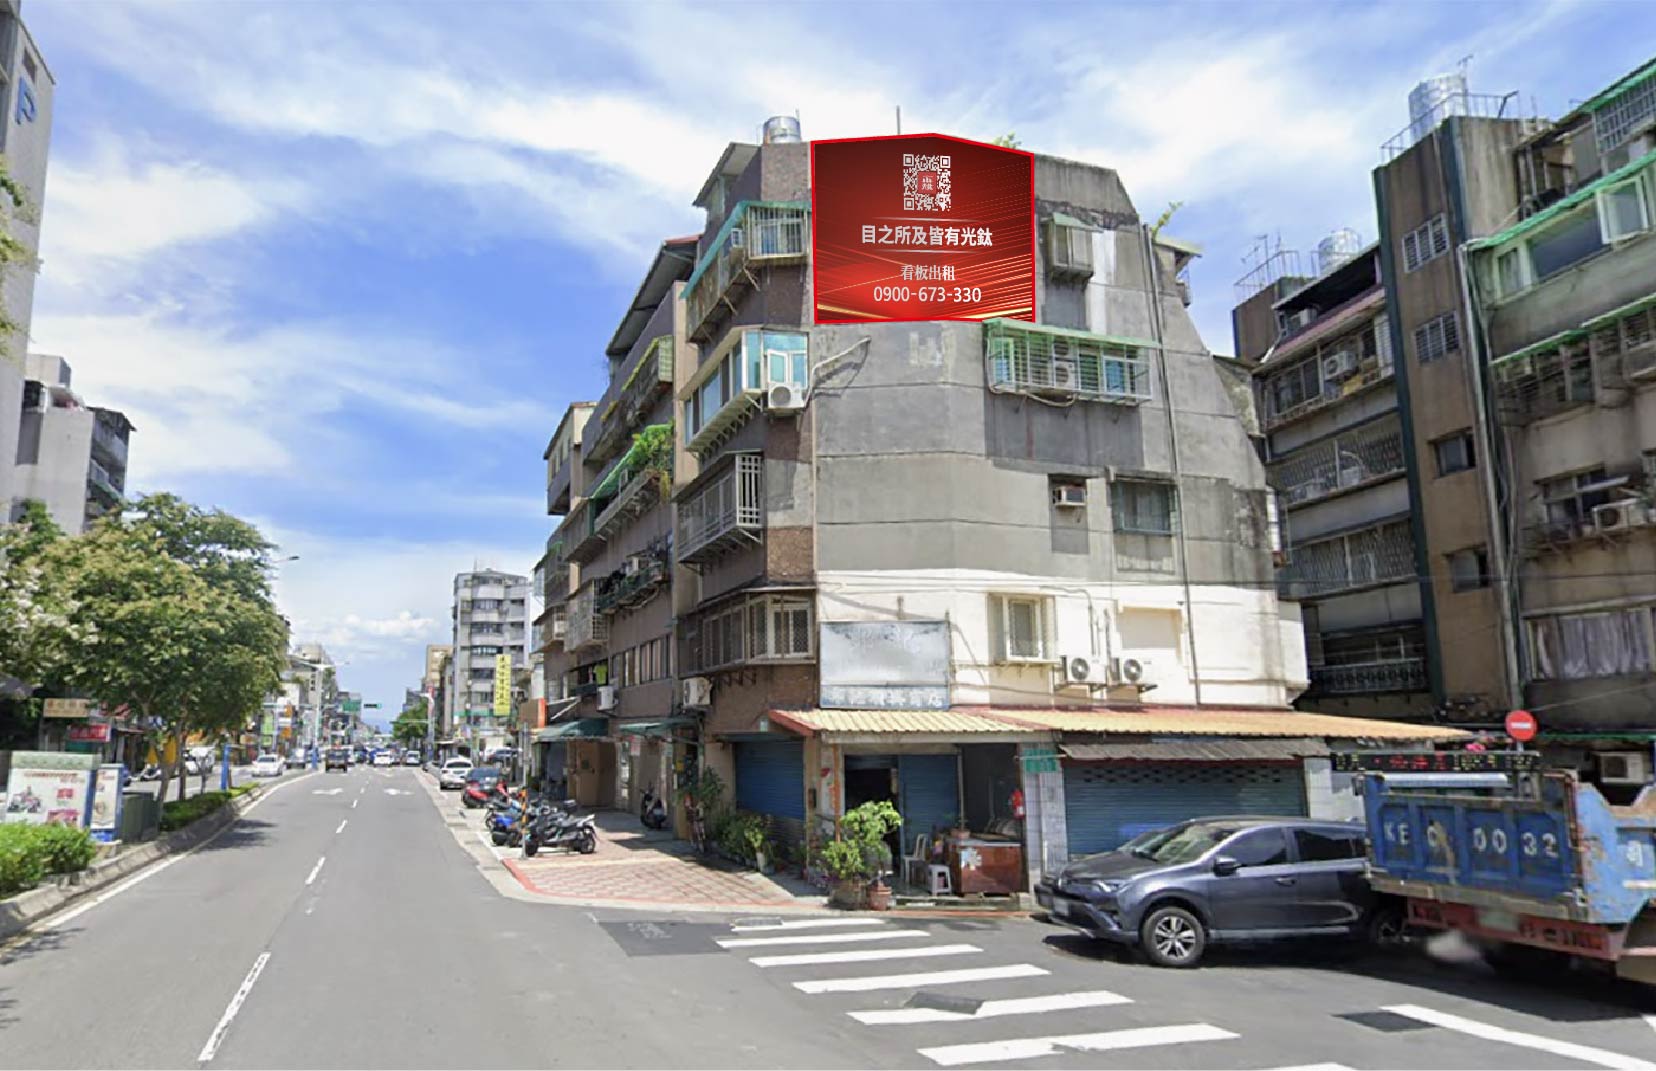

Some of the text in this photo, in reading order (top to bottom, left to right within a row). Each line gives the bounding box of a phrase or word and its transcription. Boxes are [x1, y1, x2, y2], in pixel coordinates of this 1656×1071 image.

[861, 224, 993, 247] 目之所及皆有光鈦
[901, 264, 955, 281] 看板出租
[873, 286, 982, 303] 0900-673-330
